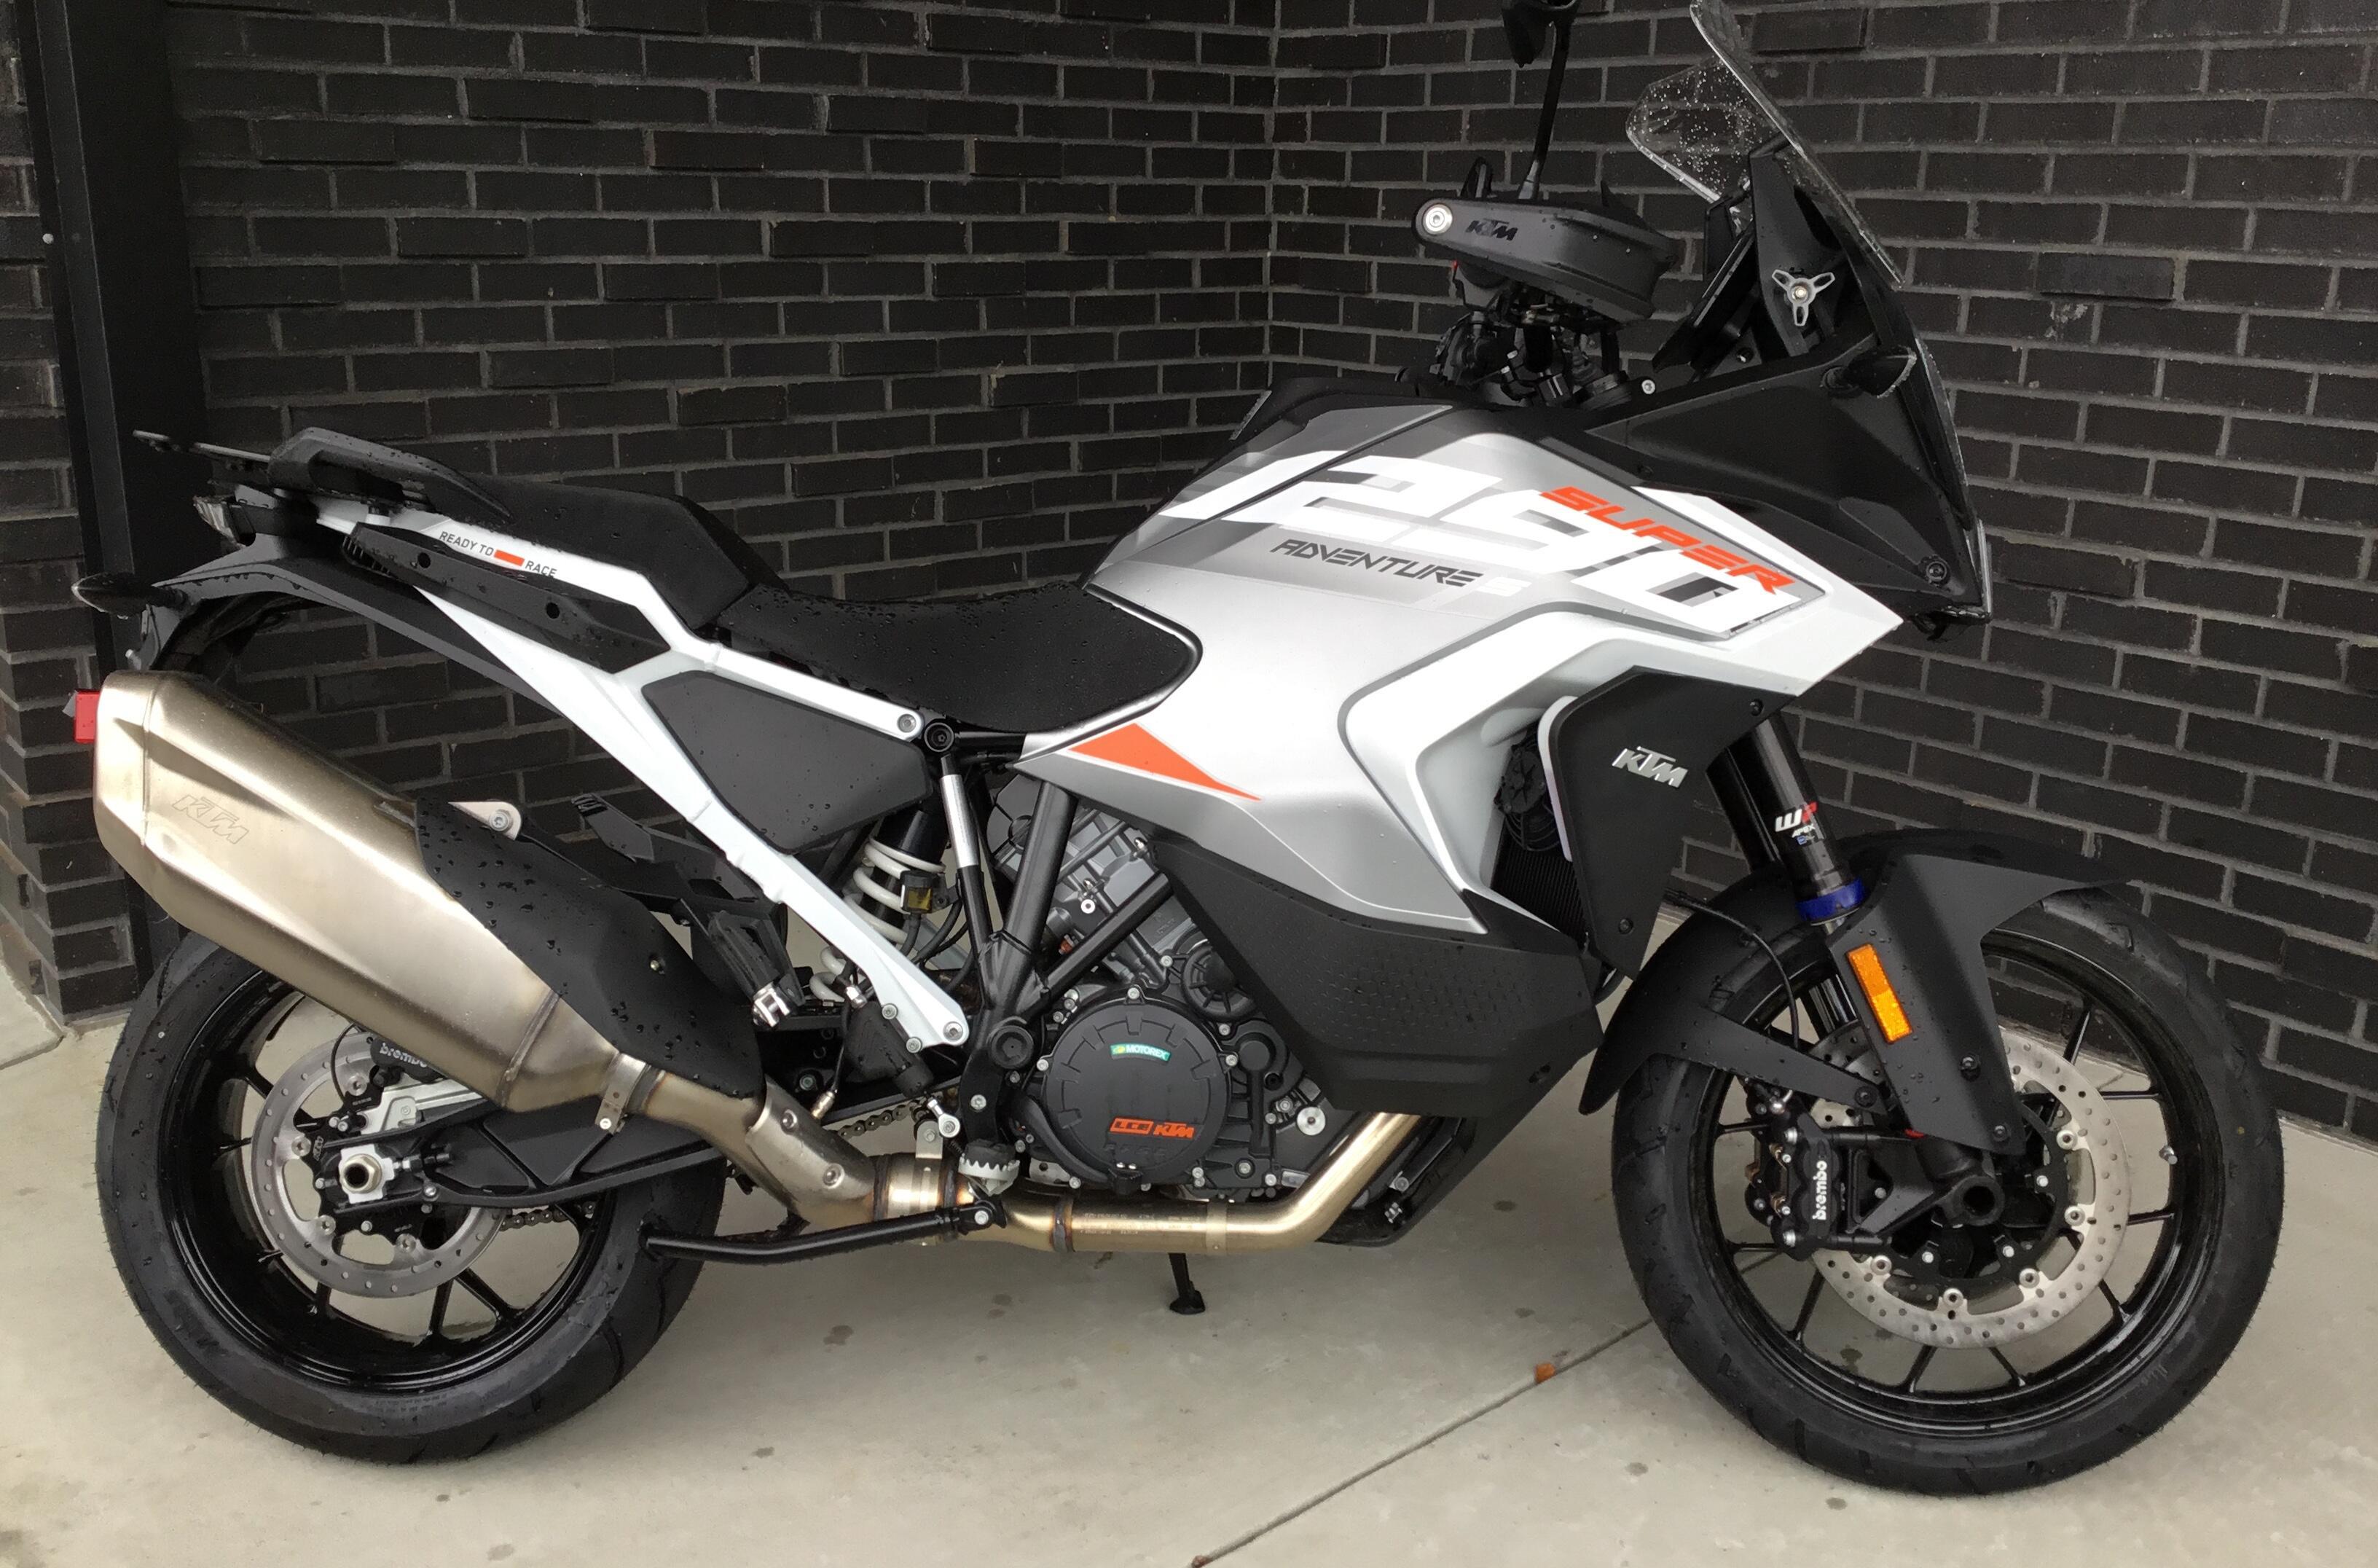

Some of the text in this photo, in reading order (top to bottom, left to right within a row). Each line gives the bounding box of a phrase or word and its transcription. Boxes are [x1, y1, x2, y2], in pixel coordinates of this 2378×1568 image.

[1465, 219, 1518, 241] KTM
[439, 530, 557, 577] READY TO RACE
[1269, 538, 1485, 587] ADVENTURE
[1538, 485, 1797, 595] SUPER
[1612, 745, 1689, 788] KTM
[170, 793, 250, 845] KTM
[1126, 1043, 1170, 1061] MOTOREX
[1153, 1121, 1195, 1139] KTM
[1812, 1160, 1827, 1220] brembo
